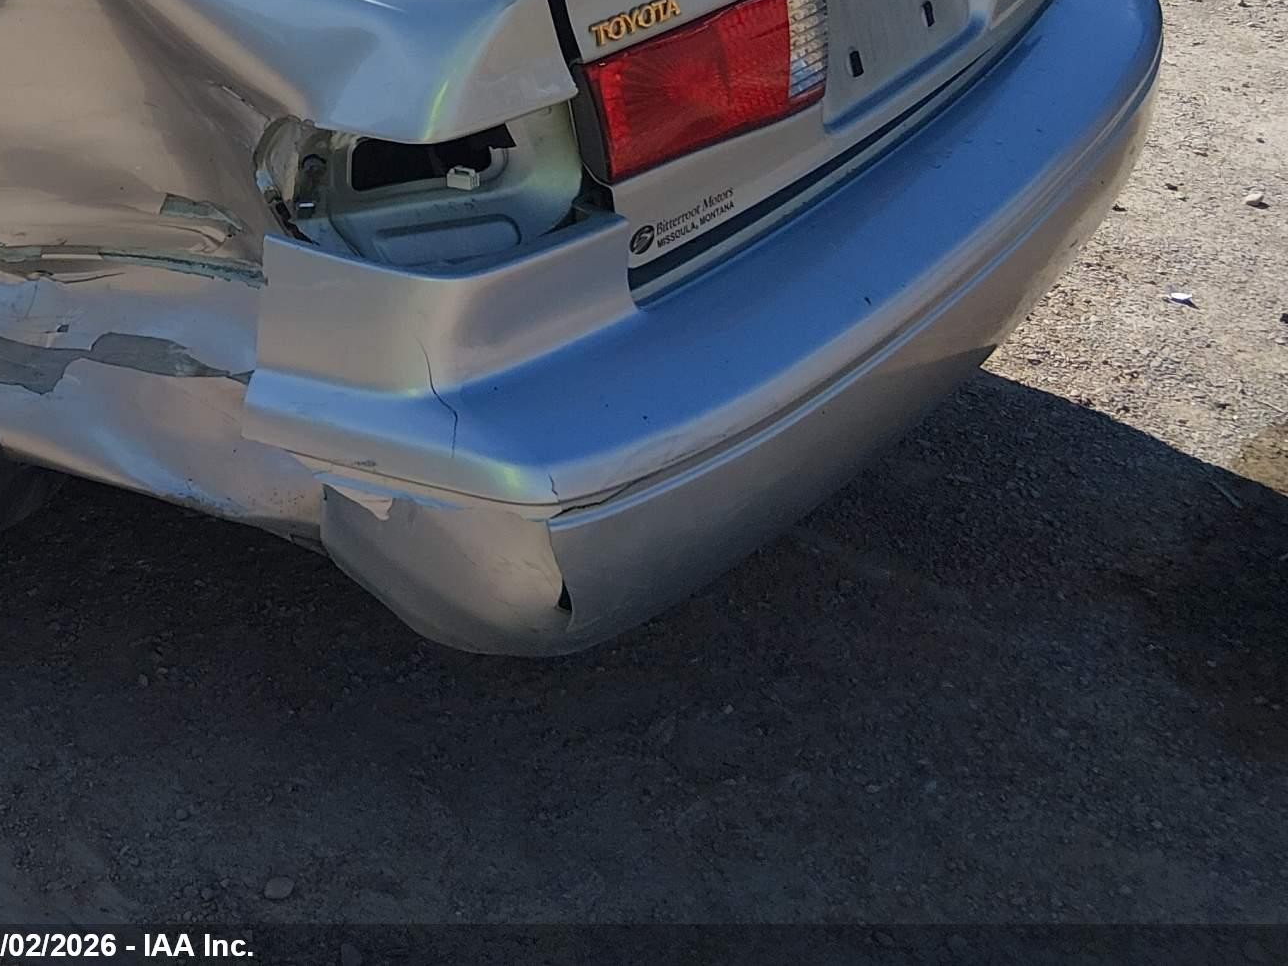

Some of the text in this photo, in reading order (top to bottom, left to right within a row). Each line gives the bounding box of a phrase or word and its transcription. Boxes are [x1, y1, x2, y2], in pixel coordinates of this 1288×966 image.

[655, 187, 734, 235] Bitterroot Motors
[656, 201, 735, 248] MISSOULA, MONTANA
